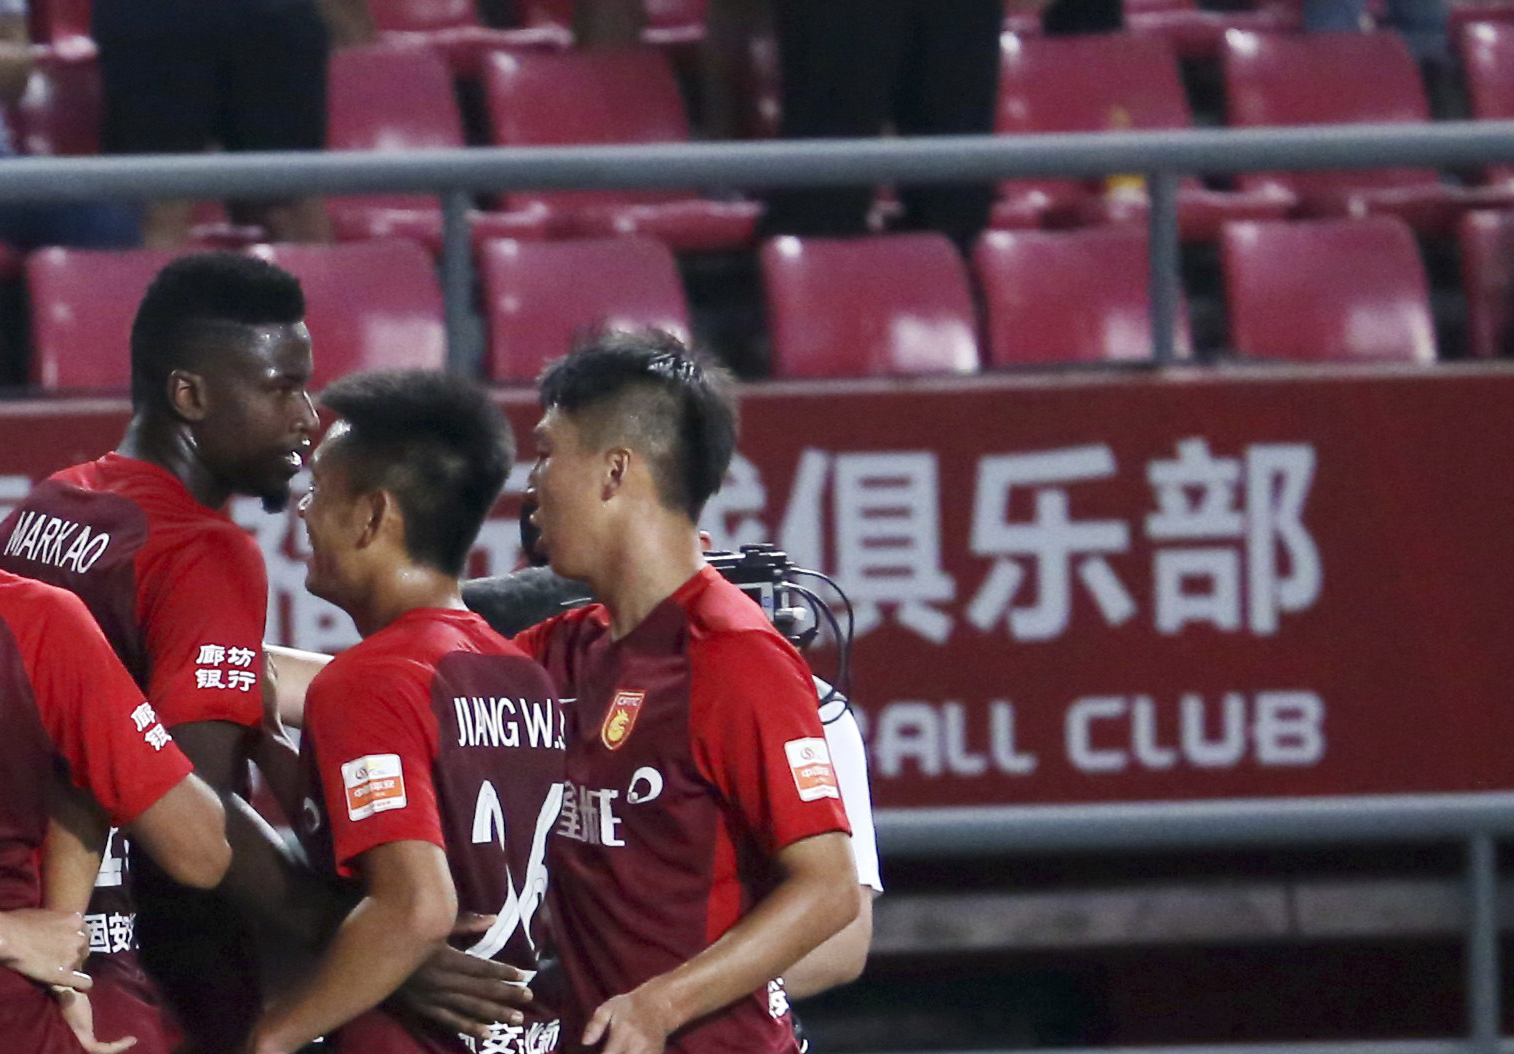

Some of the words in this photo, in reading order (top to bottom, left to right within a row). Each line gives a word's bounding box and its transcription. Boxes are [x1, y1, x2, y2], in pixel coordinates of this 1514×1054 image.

[4, 511, 110, 574] MARKAO
[194, 668, 256, 692] 银行
[195, 644, 256, 668] 廊坊
[453, 697, 520, 748] JIANG
[864, 700, 1038, 776] ALL
[1064, 690, 1326, 773] CLUB
